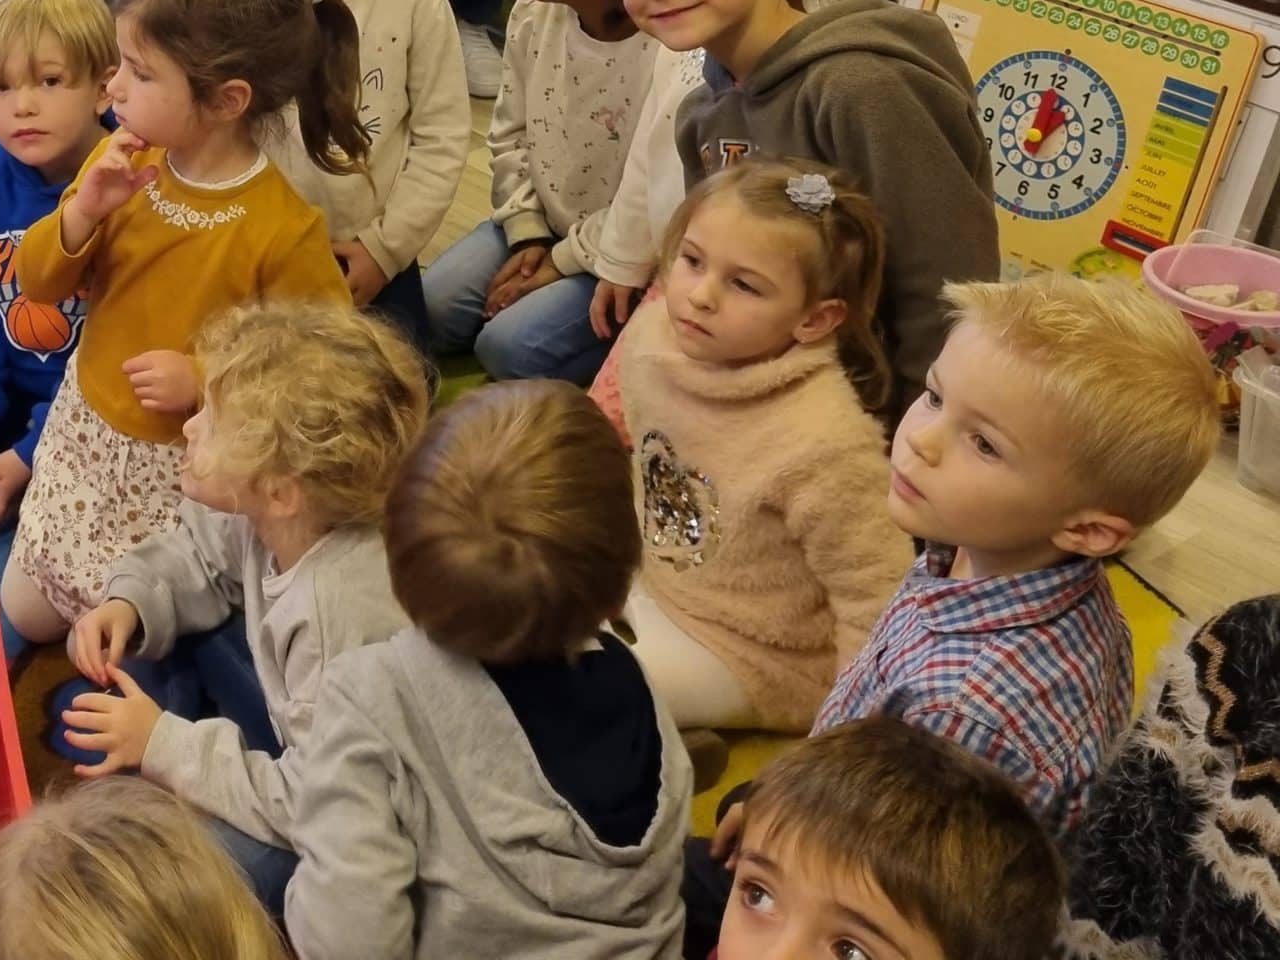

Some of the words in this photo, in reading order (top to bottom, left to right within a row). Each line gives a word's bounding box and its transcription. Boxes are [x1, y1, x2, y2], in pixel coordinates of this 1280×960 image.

[1102, 0, 1115, 10] 10
[1121, 5, 1131, 16] 11
[1138, 10, 1150, 22] 12
[1156, 16, 1169, 27] 13
[1174, 22, 1187, 33] 14
[1193, 27, 1206, 39] 15
[1213, 34, 1225, 46] 16
[1032, 4, 1045, 15] 22
[1050, 10, 1063, 21] 23
[1067, 16, 1081, 27] 24
[1086, 21, 1100, 33] 25
[1105, 28, 1119, 40] 26
[1123, 34, 1138, 45] 27
[1143, 40, 1157, 52] 28
[1163, 46, 1177, 59] 29
[1182, 53, 1197, 65] 30
[1203, 59, 1217, 73] 31
[1023, 71, 1039, 89] 11
[1049, 73, 1068, 91] 12
[998, 83, 1016, 101] 10
[1081, 92, 1091, 108] 1
[983, 107, 995, 123] 9
[1089, 118, 1103, 135] 2
[1089, 148, 1103, 164] 3
[994, 161, 1007, 177] 7
[1141, 164, 1168, 178] JUILLET
[1017, 180, 1030, 196] 6
[1071, 174, 1085, 190] 4
[1047, 183, 1061, 200] 5
[1130, 190, 1173, 210] SEPTEMBRE
[1125, 203, 1164, 223] OCTOBRE
